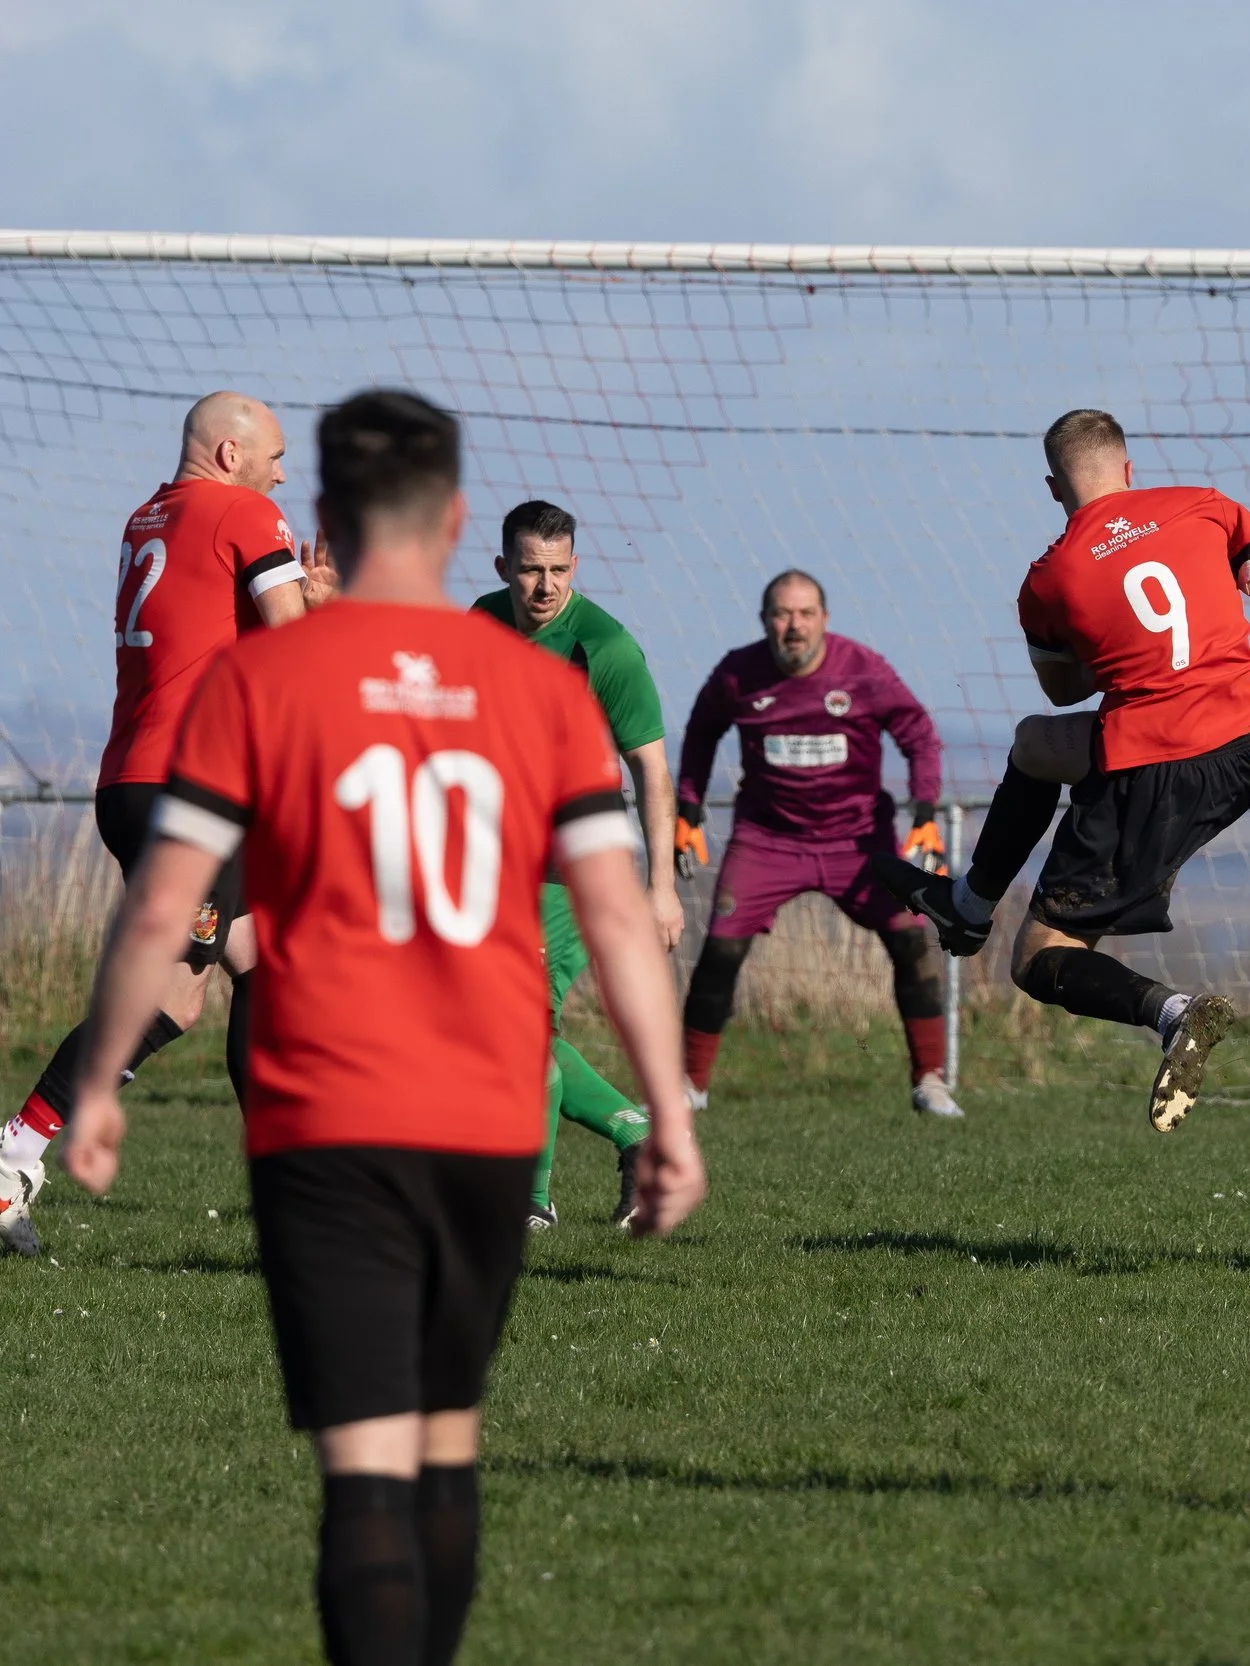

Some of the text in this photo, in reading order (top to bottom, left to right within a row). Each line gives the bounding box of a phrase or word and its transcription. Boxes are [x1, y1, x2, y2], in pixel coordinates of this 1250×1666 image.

[1091, 521, 1157, 555] RG HOWELLS
[1094, 541, 1127, 561] cleaning
[1123, 561, 1190, 671] 9
[335, 743, 504, 948] 10
